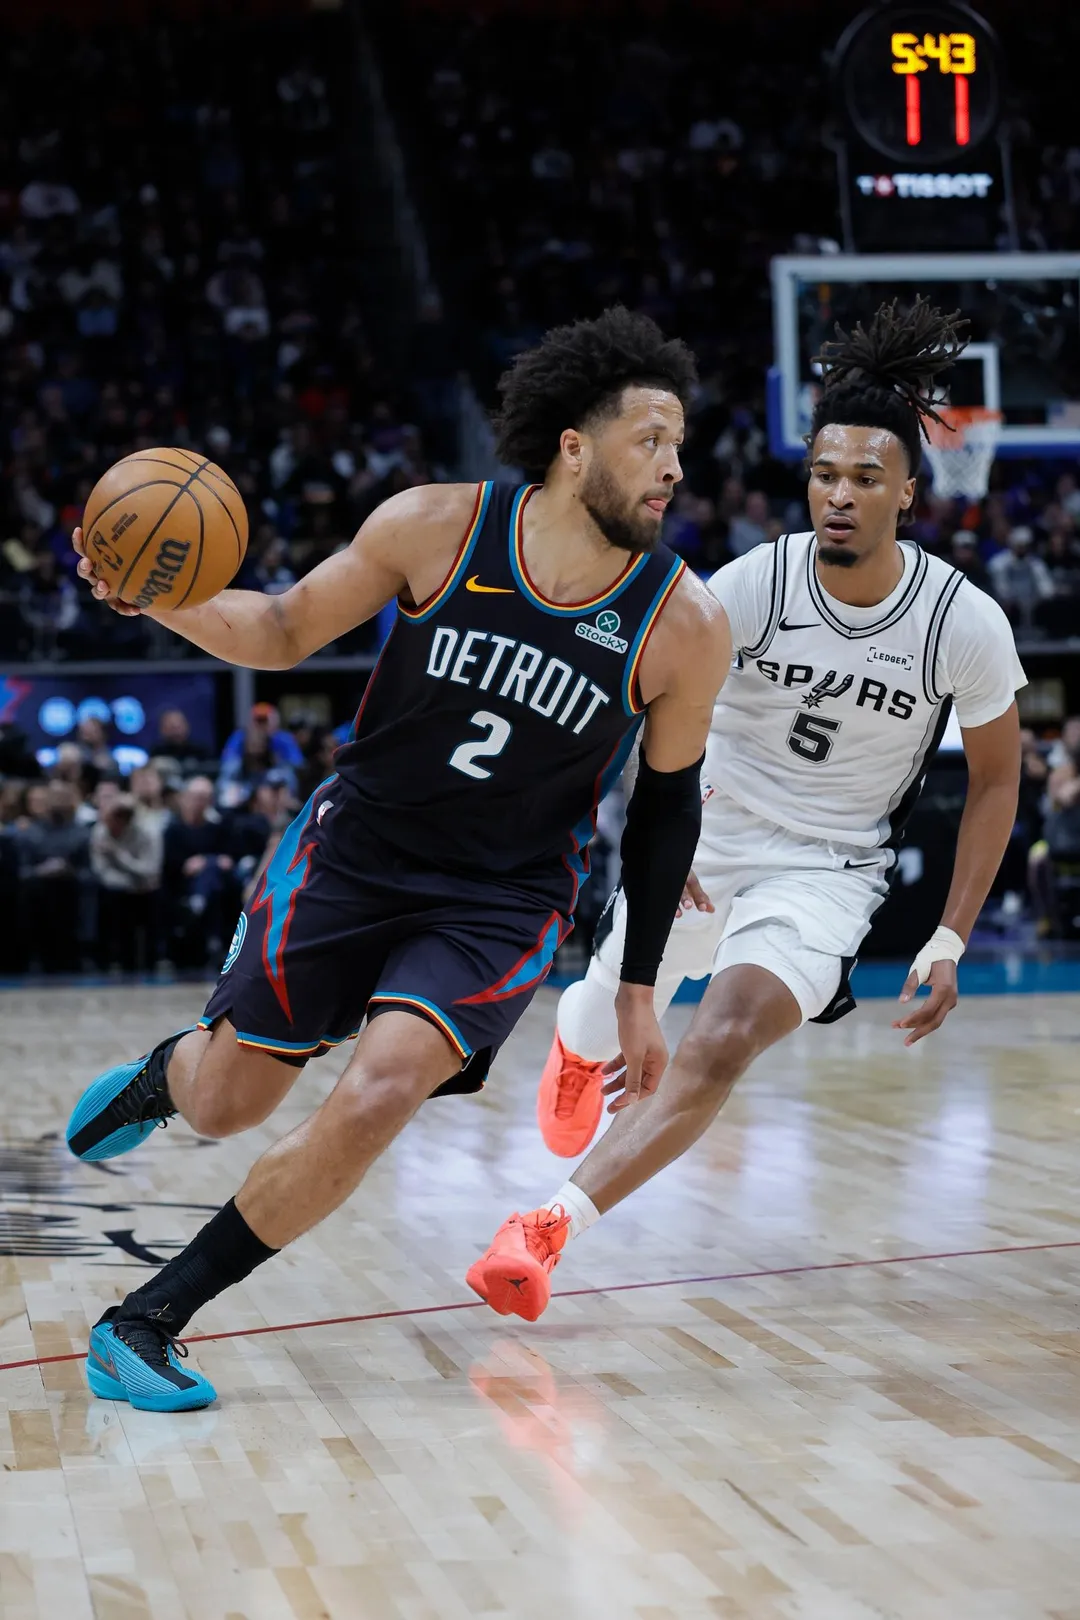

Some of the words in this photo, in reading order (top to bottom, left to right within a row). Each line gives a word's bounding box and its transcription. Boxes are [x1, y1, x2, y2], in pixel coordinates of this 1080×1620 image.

[891, 32, 976, 74] 5:43
[906, 74, 969, 146] 11
[891, 172, 993, 198] TISSOT
[426, 625, 611, 736] DETROIT
[873, 651, 908, 667] LEDGER
[756, 659, 917, 720] SPURS
[448, 709, 513, 780] 2
[785, 710, 843, 767] 5
